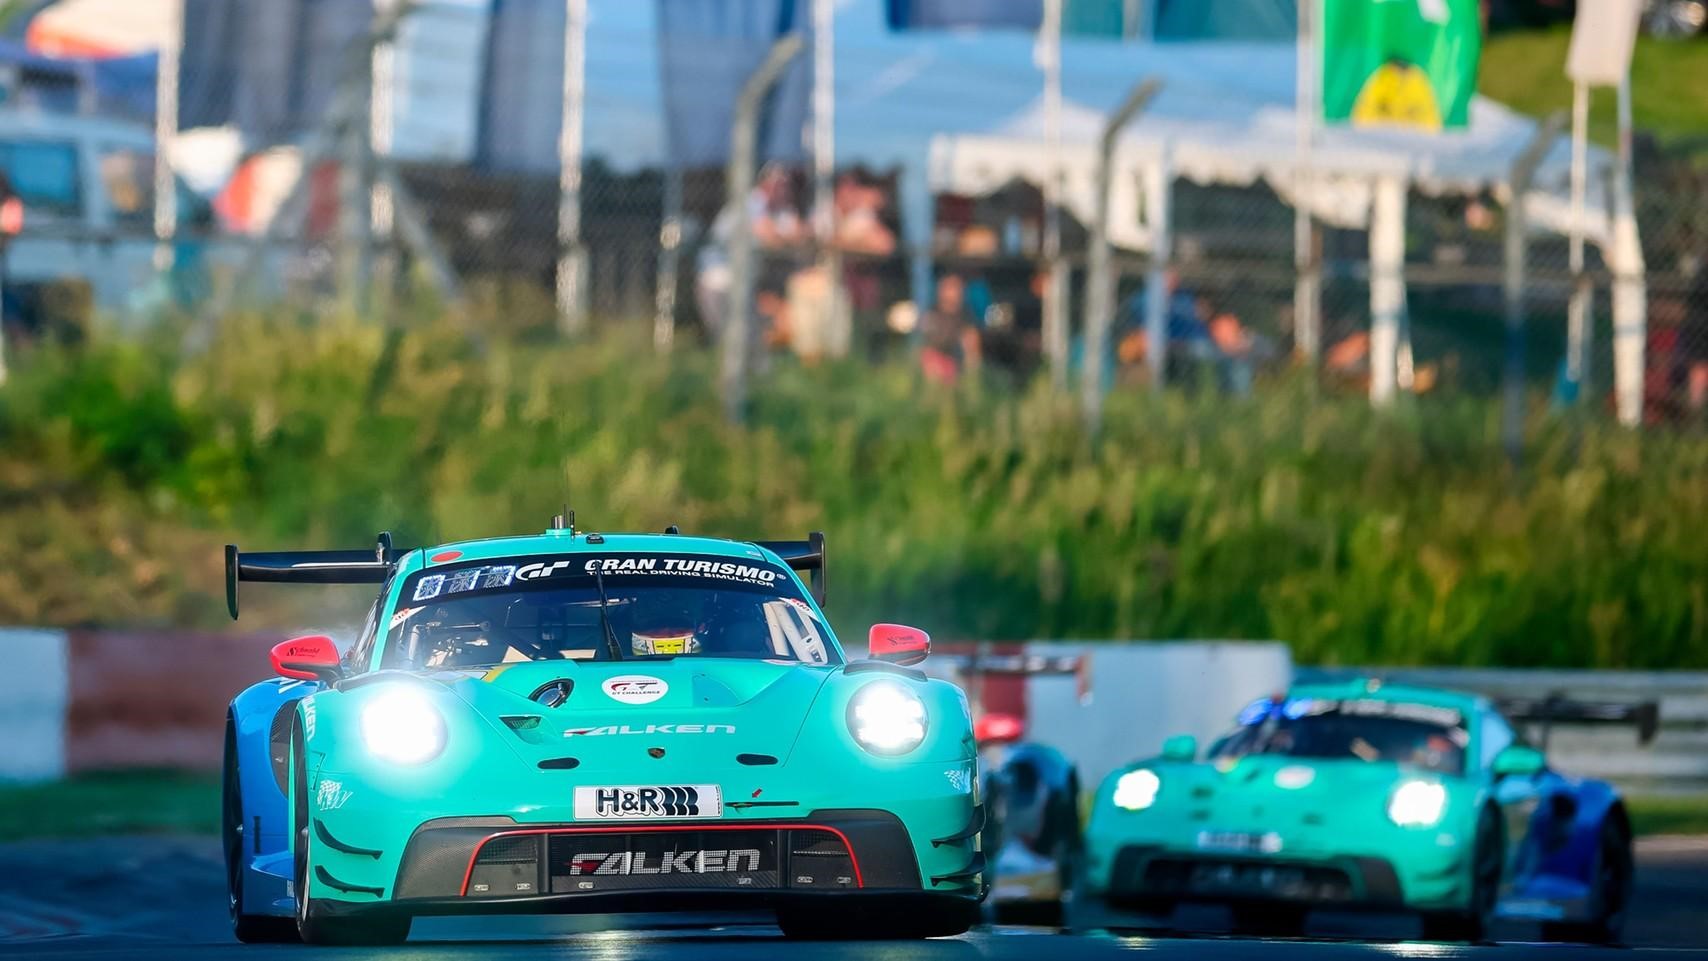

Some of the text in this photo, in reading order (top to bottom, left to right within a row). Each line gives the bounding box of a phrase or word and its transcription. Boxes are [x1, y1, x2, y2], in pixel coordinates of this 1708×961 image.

[585, 559, 656, 570] GRAN
[704, 571, 774, 588] SIMULATOR
[563, 724, 736, 738] FALKEN
[596, 787, 665, 816] H&R
[568, 849, 760, 875] FALKEN
